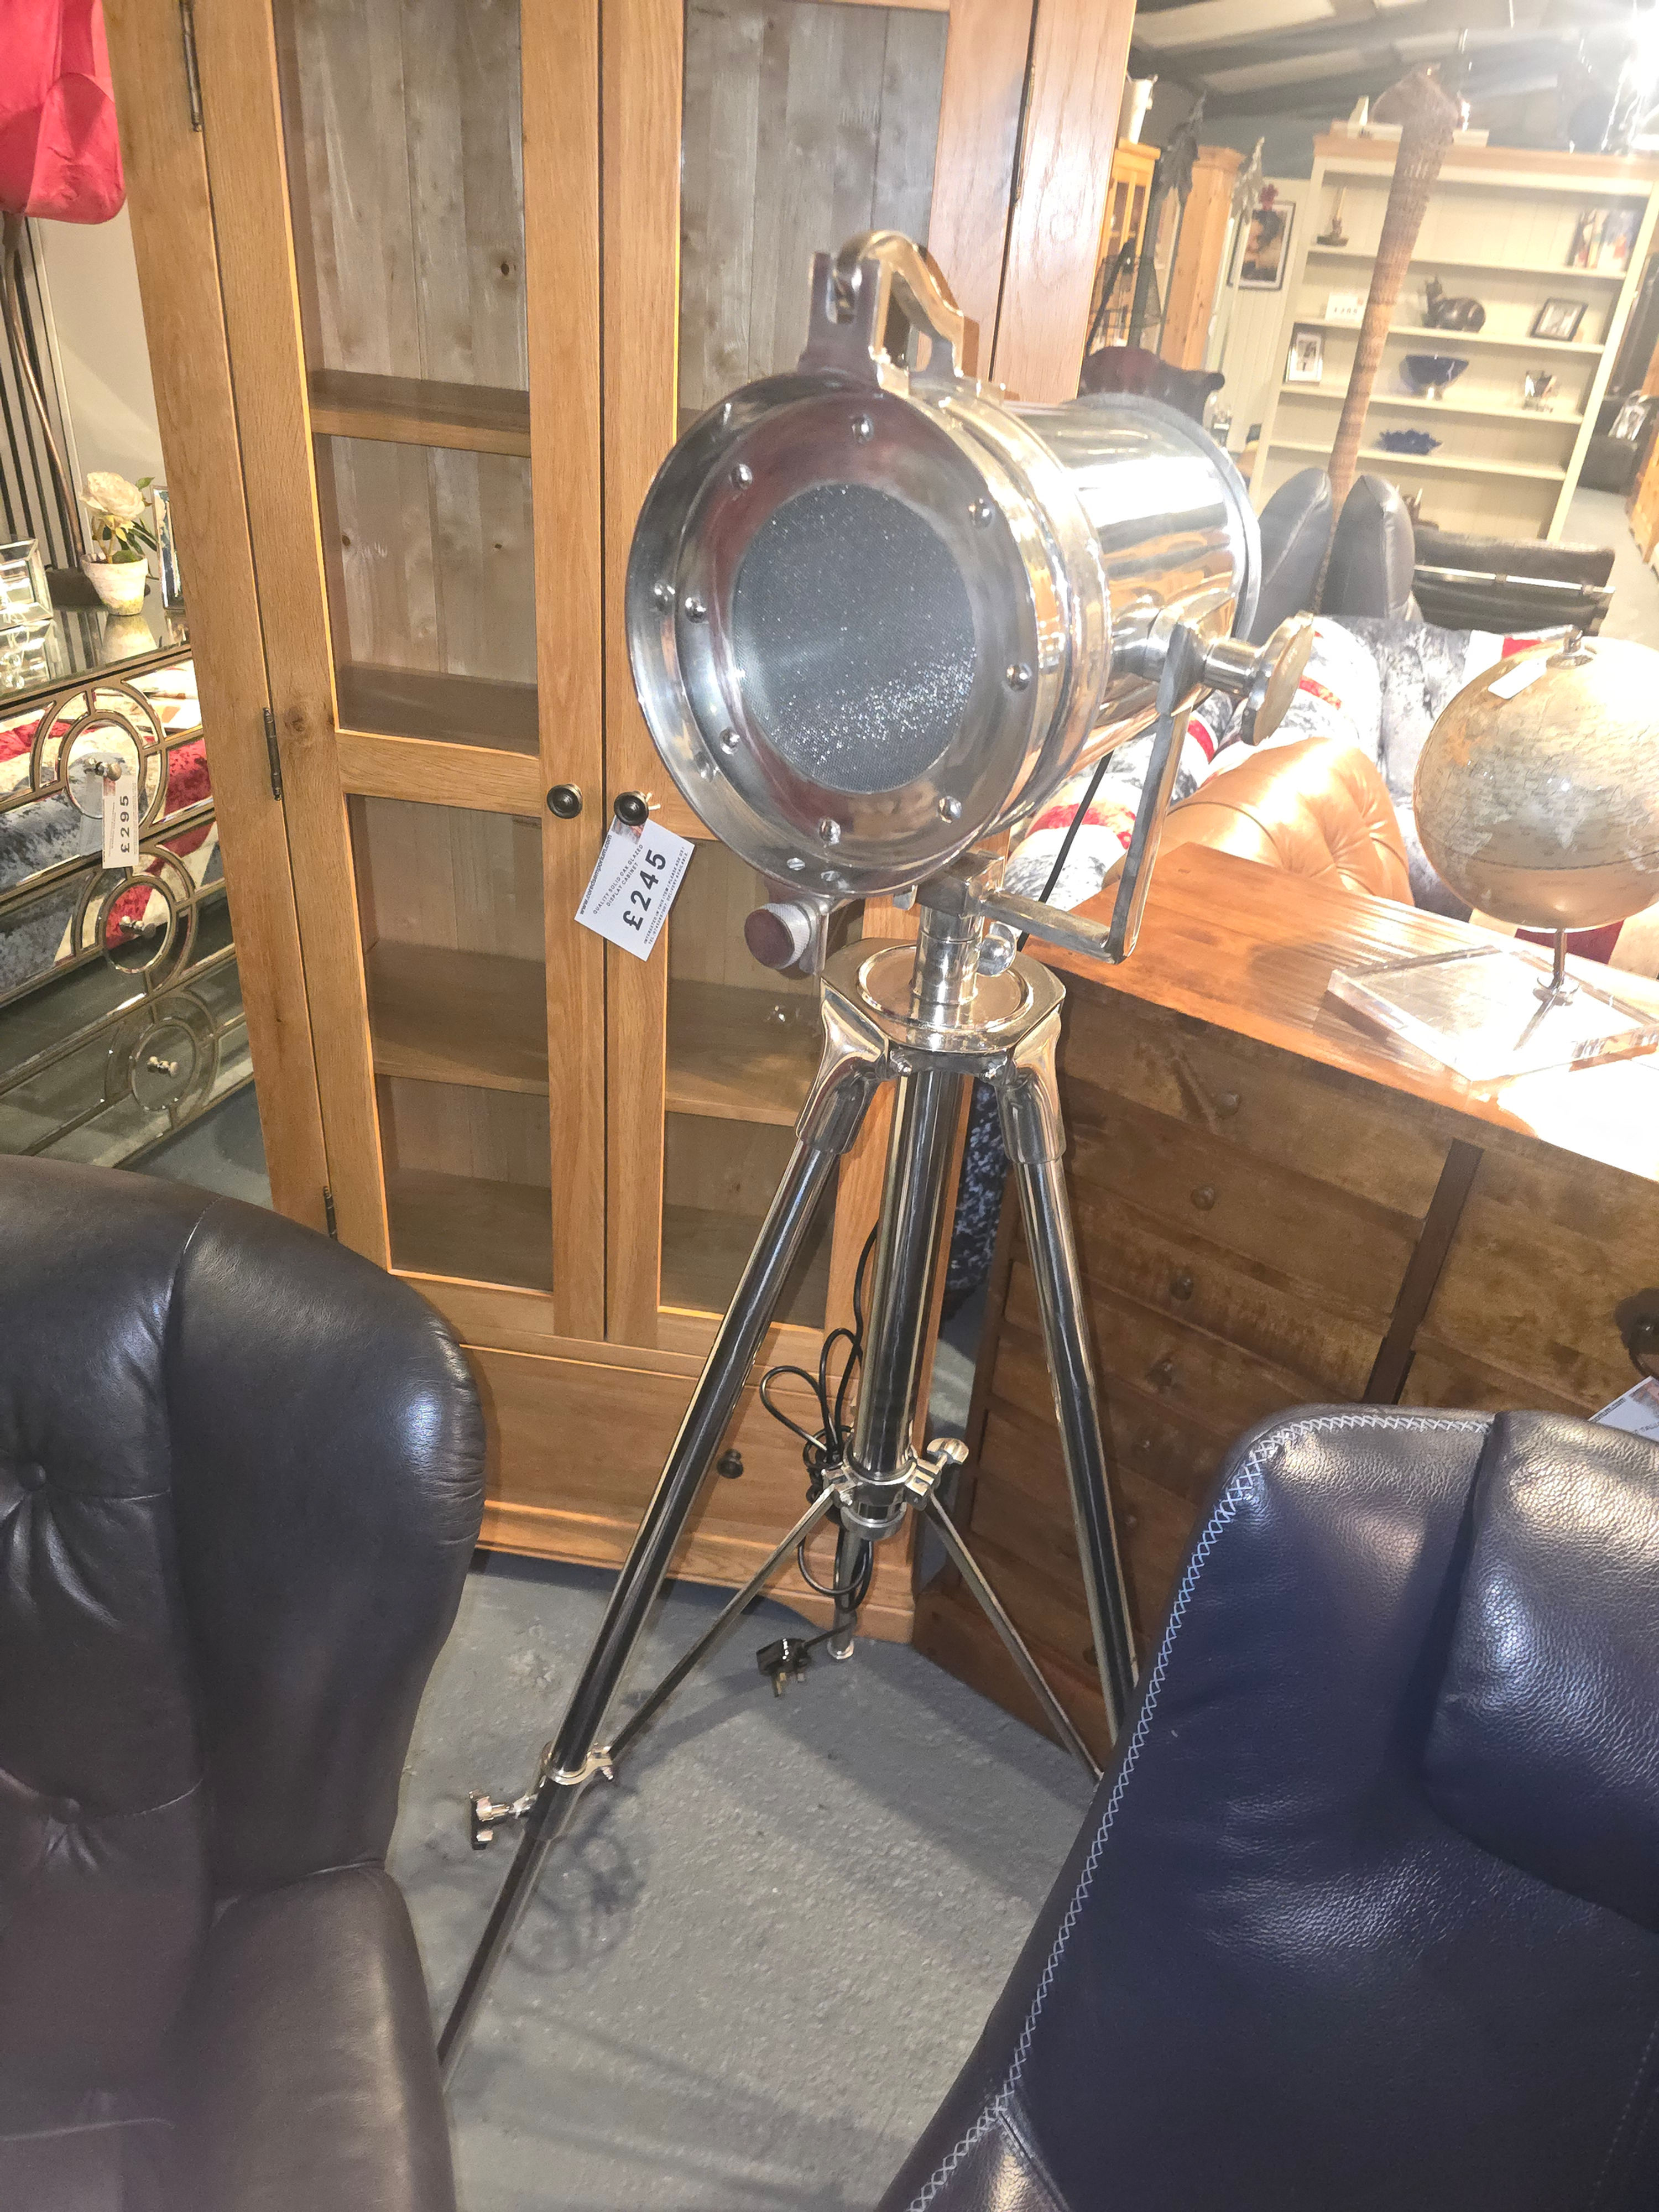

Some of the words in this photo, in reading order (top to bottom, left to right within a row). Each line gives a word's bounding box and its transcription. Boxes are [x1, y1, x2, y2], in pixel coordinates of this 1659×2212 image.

[120, 795, 130, 853] £295
[593, 892, 609, 915] QUALITY
[608, 877, 620, 893] SOLID
[619, 864, 629, 877] OAK
[628, 844, 643, 865] GLAZED
[606, 885, 623, 907] DISPLAY
[622, 862, 639, 885] CABINET
[623, 849, 666, 931] £245
